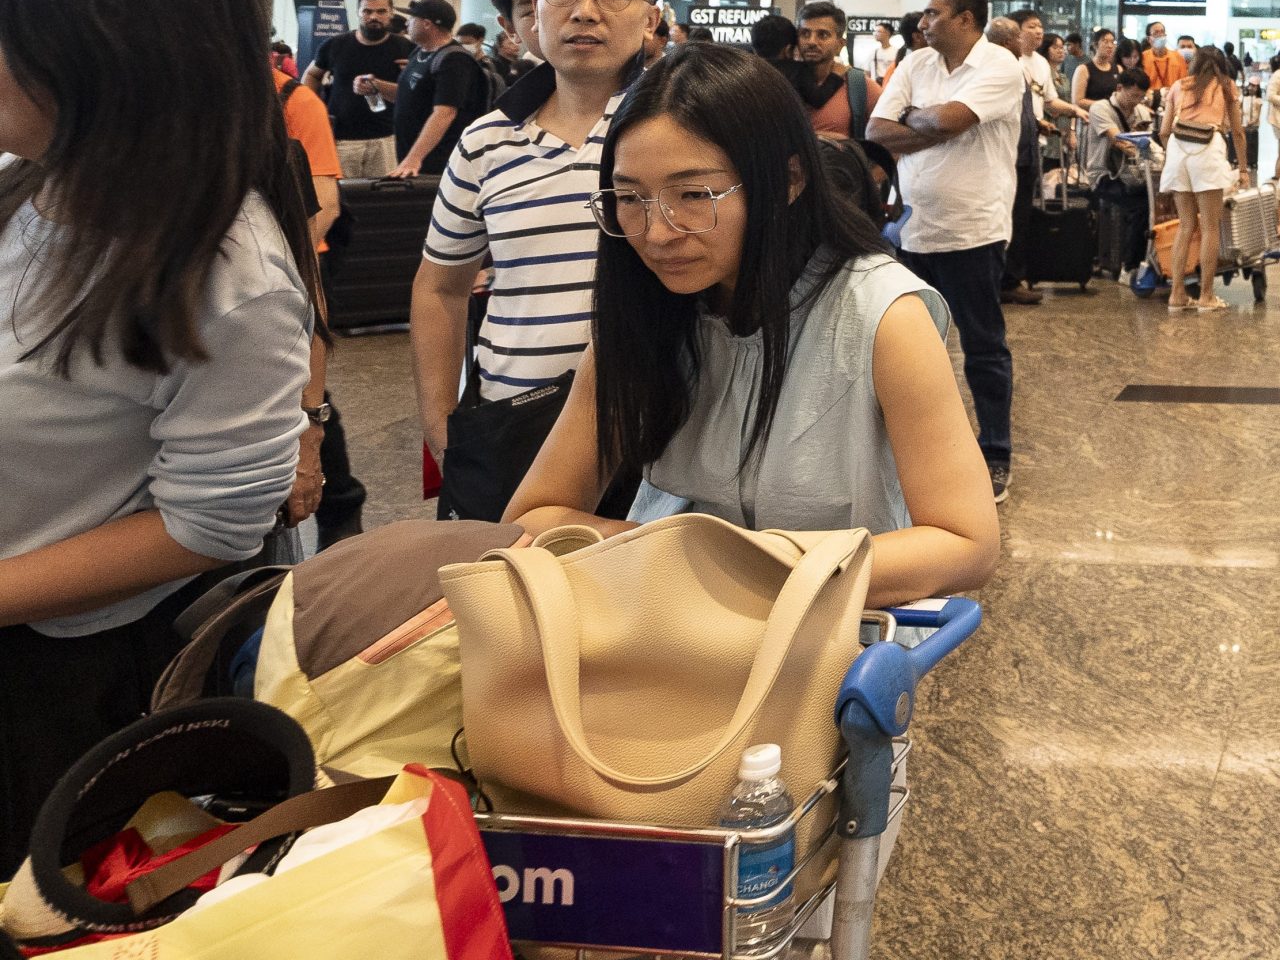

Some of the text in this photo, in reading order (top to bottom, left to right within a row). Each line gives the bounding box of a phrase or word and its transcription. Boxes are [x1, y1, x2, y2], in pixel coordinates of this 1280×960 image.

[690, 8, 717, 24] GST
[848, 19, 868, 31] GST
[491, 864, 575, 906] om
